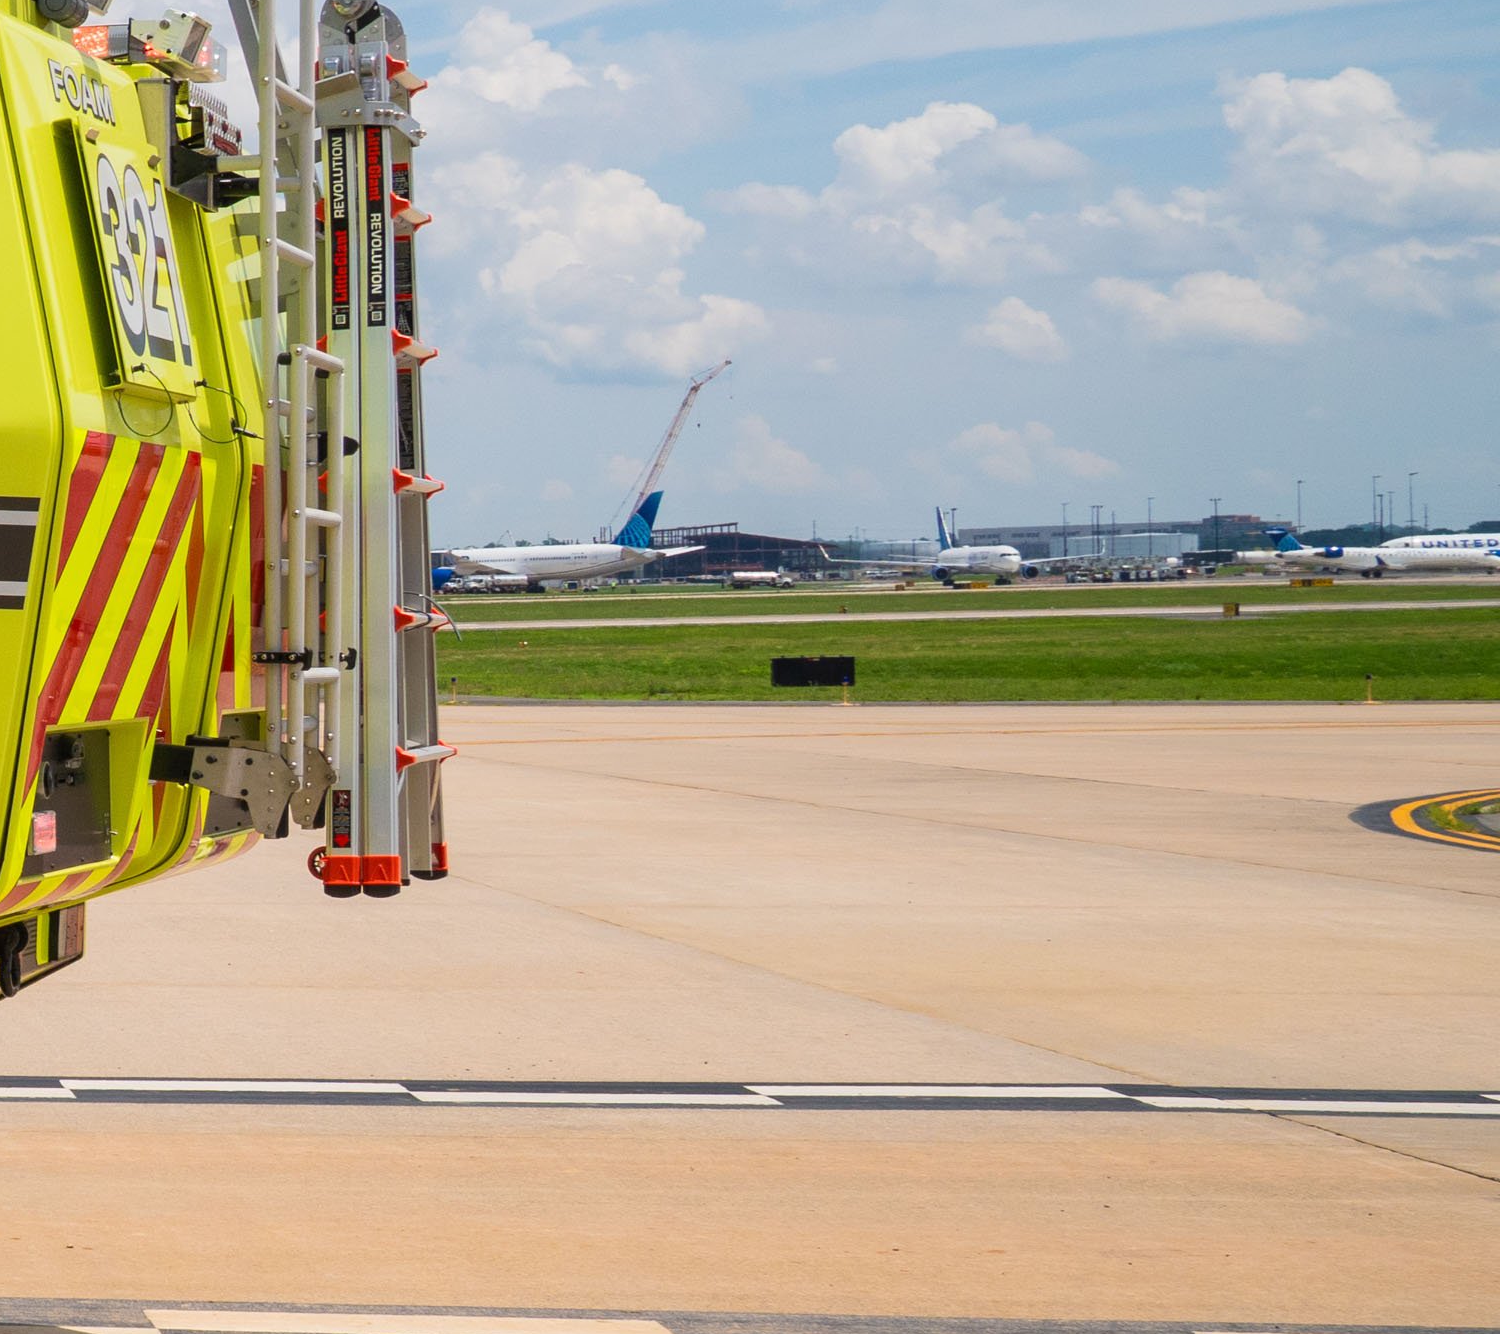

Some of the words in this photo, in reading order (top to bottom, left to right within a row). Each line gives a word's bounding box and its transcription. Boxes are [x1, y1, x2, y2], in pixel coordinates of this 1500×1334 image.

[48, 58, 116, 127] FOAM
[332, 137, 346, 218] REVOLUTION
[97, 153, 193, 367] 321
[370, 212, 383, 294] REVOLUTION
[1422, 539, 1499, 548] UNITED
